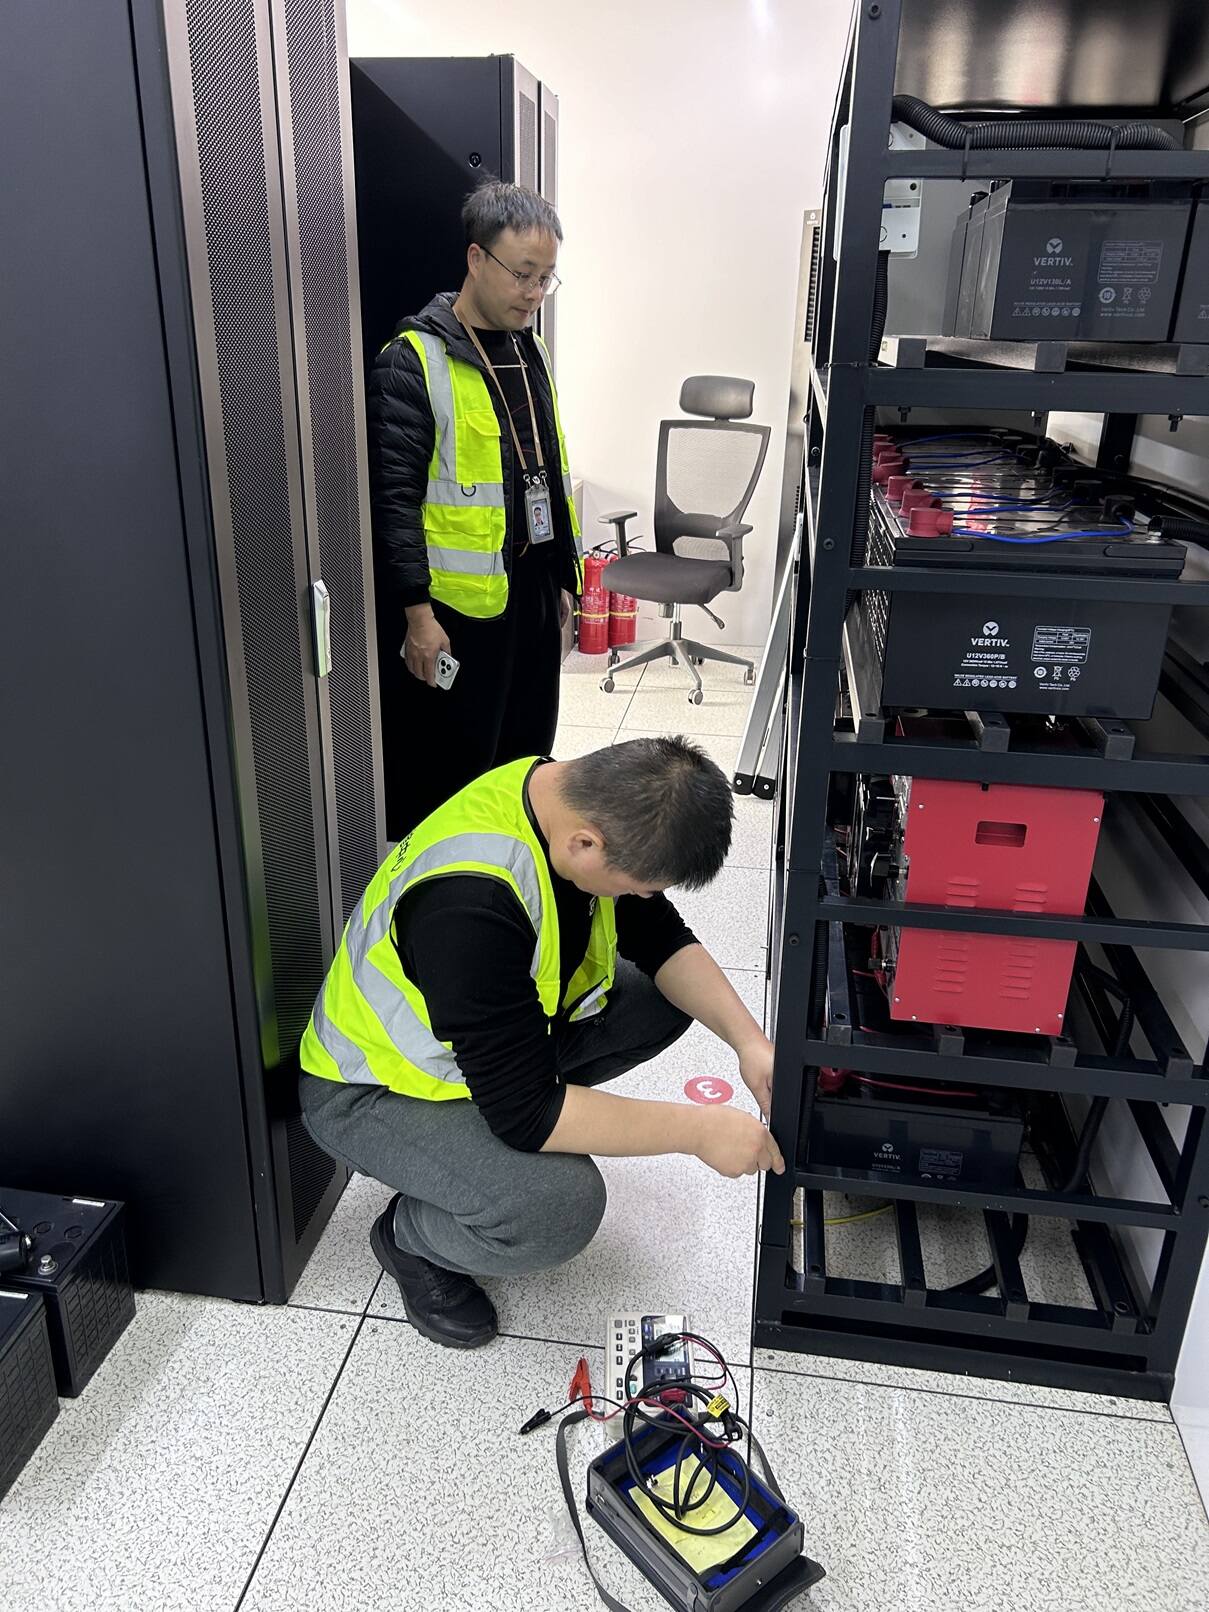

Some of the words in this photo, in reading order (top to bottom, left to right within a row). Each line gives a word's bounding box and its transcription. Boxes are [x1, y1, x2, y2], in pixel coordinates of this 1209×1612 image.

[1033, 257, 1072, 266] VERTIV
[971, 638, 1008, 647] VERTIV
[873, 1152, 900, 1160] VERTIV
